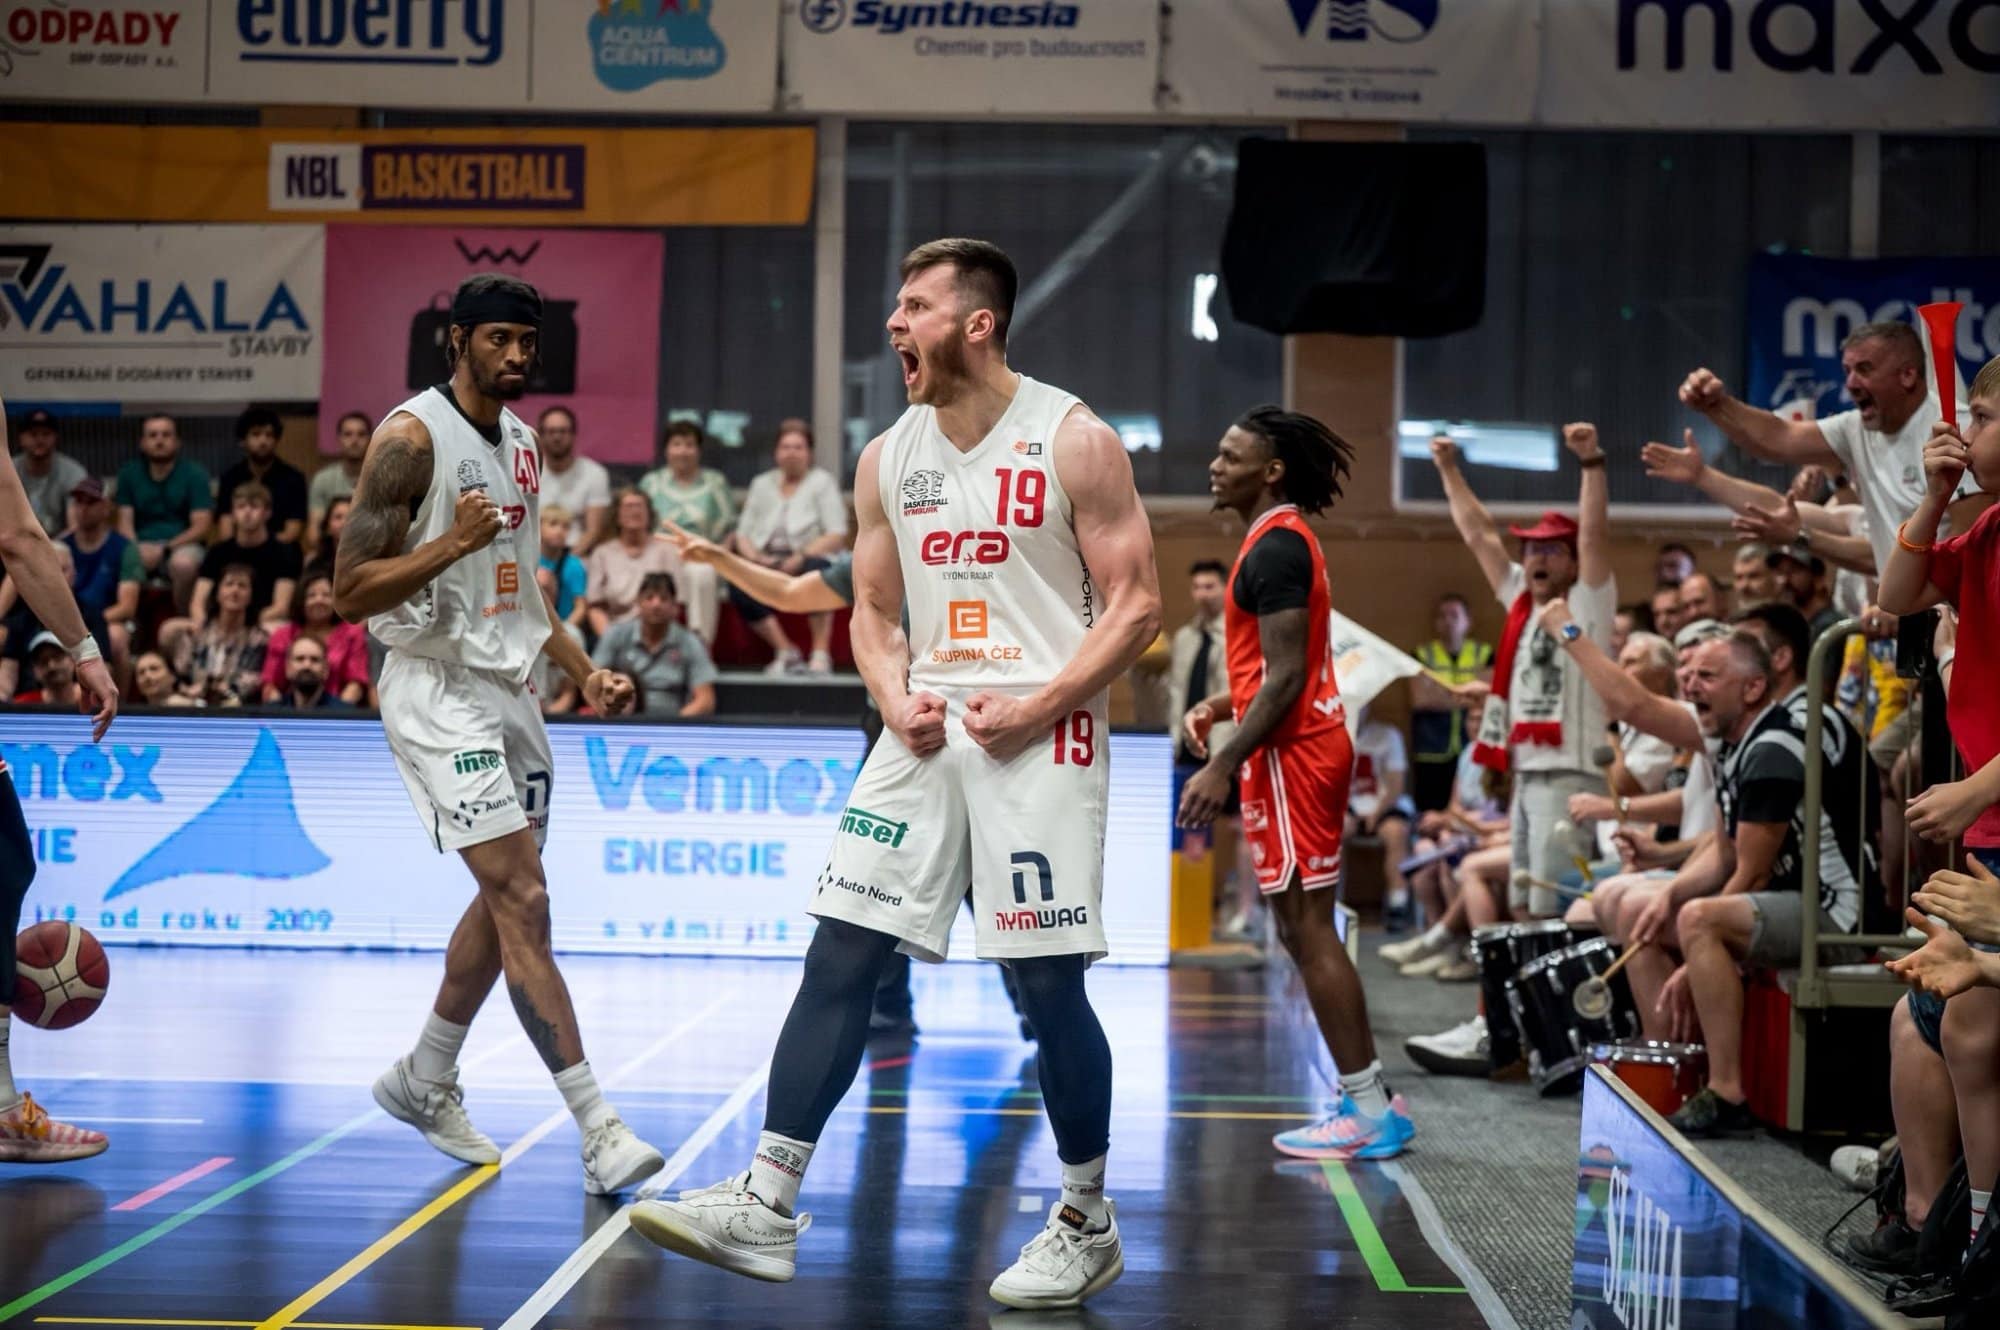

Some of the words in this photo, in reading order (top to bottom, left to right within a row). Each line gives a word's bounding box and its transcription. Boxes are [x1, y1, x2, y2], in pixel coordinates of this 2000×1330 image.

[8, 8, 181, 47] ODPADY
[236, 0, 504, 66] elberry
[852, 0, 1079, 33] Synthesia
[602, 26, 670, 46] AQUA
[914, 36, 987, 57] Chemie
[992, 40, 1026, 59] pro
[1029, 38, 1146, 57] budoucnost
[602, 46, 718, 67] CENTRUM
[372, 154, 573, 199] BASKETBALL
[2, 265, 310, 332] VAHALA
[228, 336, 313, 358] STAVBY
[199, 368, 254, 382] STAVEB
[514, 447, 540, 495] 40
[903, 499, 949, 510] BASKETBALL
[995, 467, 1046, 528] 19
[921, 530, 1010, 566] era
[990, 643, 1022, 660] ČEZ
[1053, 710, 1094, 767] 19
[603, 838, 787, 878] ENERGIE
[835, 876, 866, 895] Auto
[867, 884, 902, 906] Nord
[100, 904, 140, 929] od
[161, 907, 241, 930] roku
[266, 907, 334, 932] 2009
